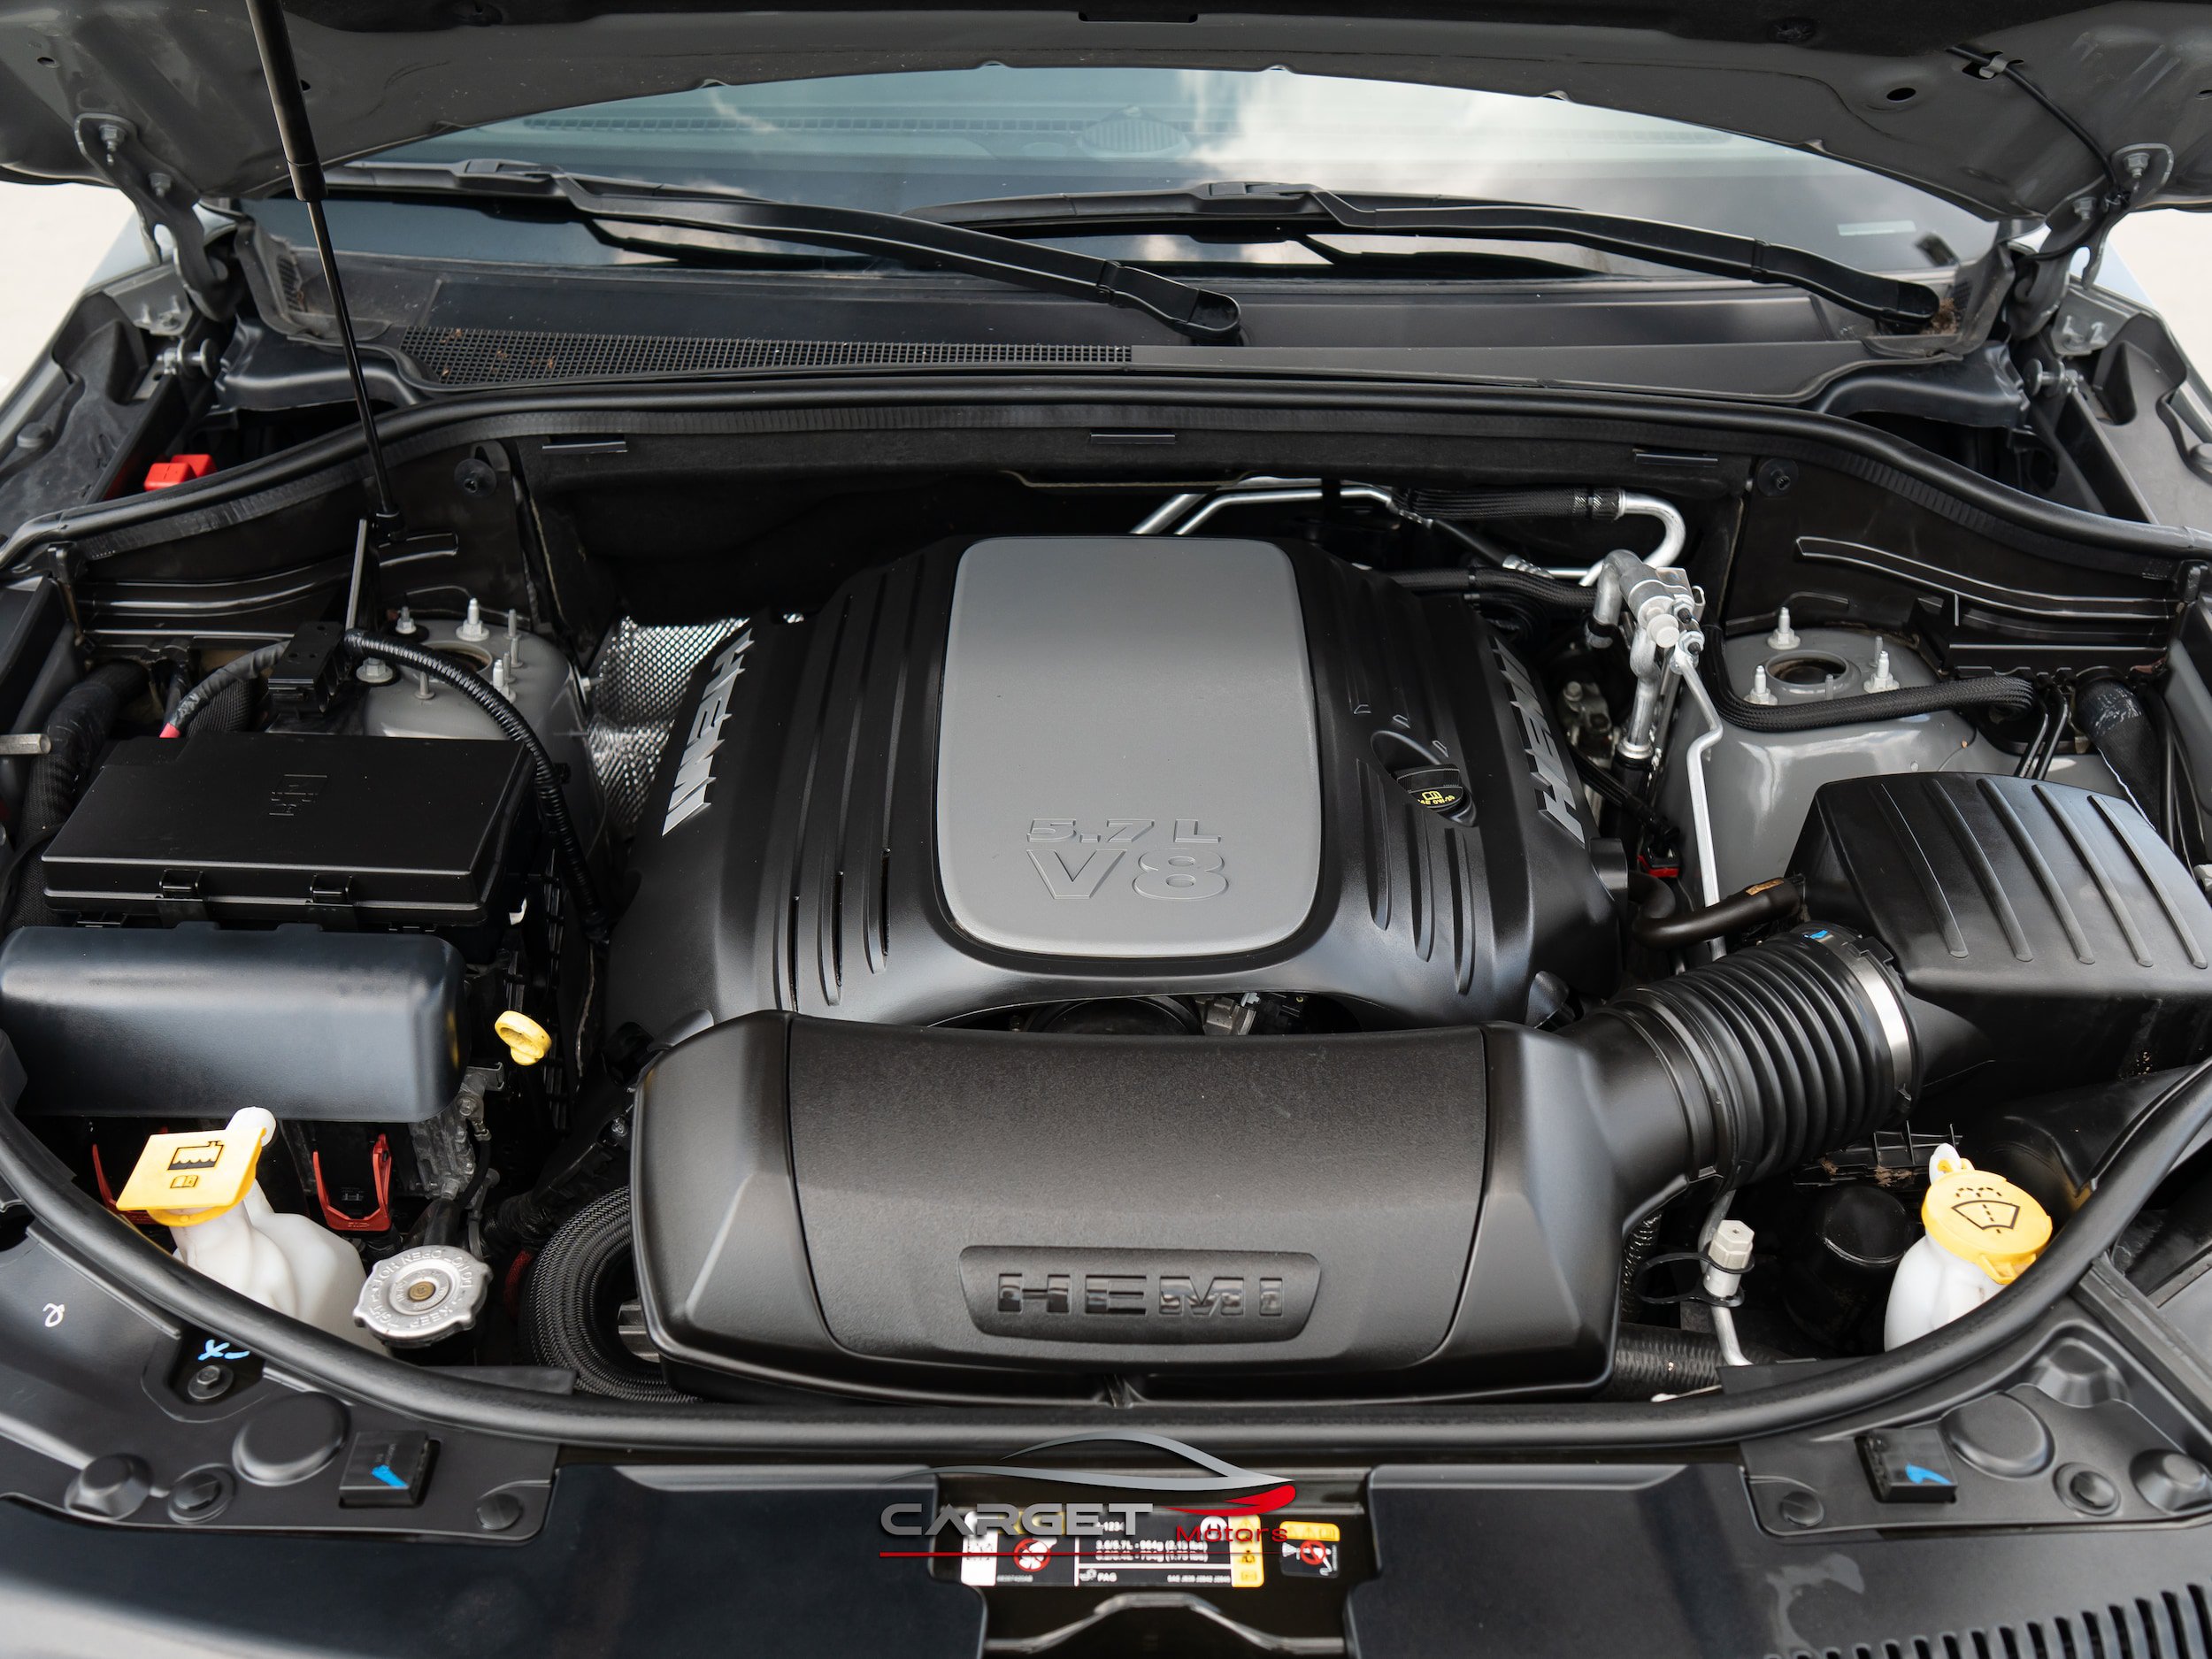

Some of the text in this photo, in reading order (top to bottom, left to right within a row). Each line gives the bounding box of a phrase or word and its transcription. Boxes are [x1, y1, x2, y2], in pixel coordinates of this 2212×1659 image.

[662, 626, 756, 837] HEMI
[1490, 635, 1586, 848] HEMI
[1026, 818, 1222, 843] 5.7 L
[1025, 849, 1229, 900] V8
[403, 1249, 443, 1265] OPEN
[997, 1272, 1284, 1317] HEMI
[368, 1305, 454, 1329] KEEP TGHT
[1097, 1571, 1118, 1583] PAG
